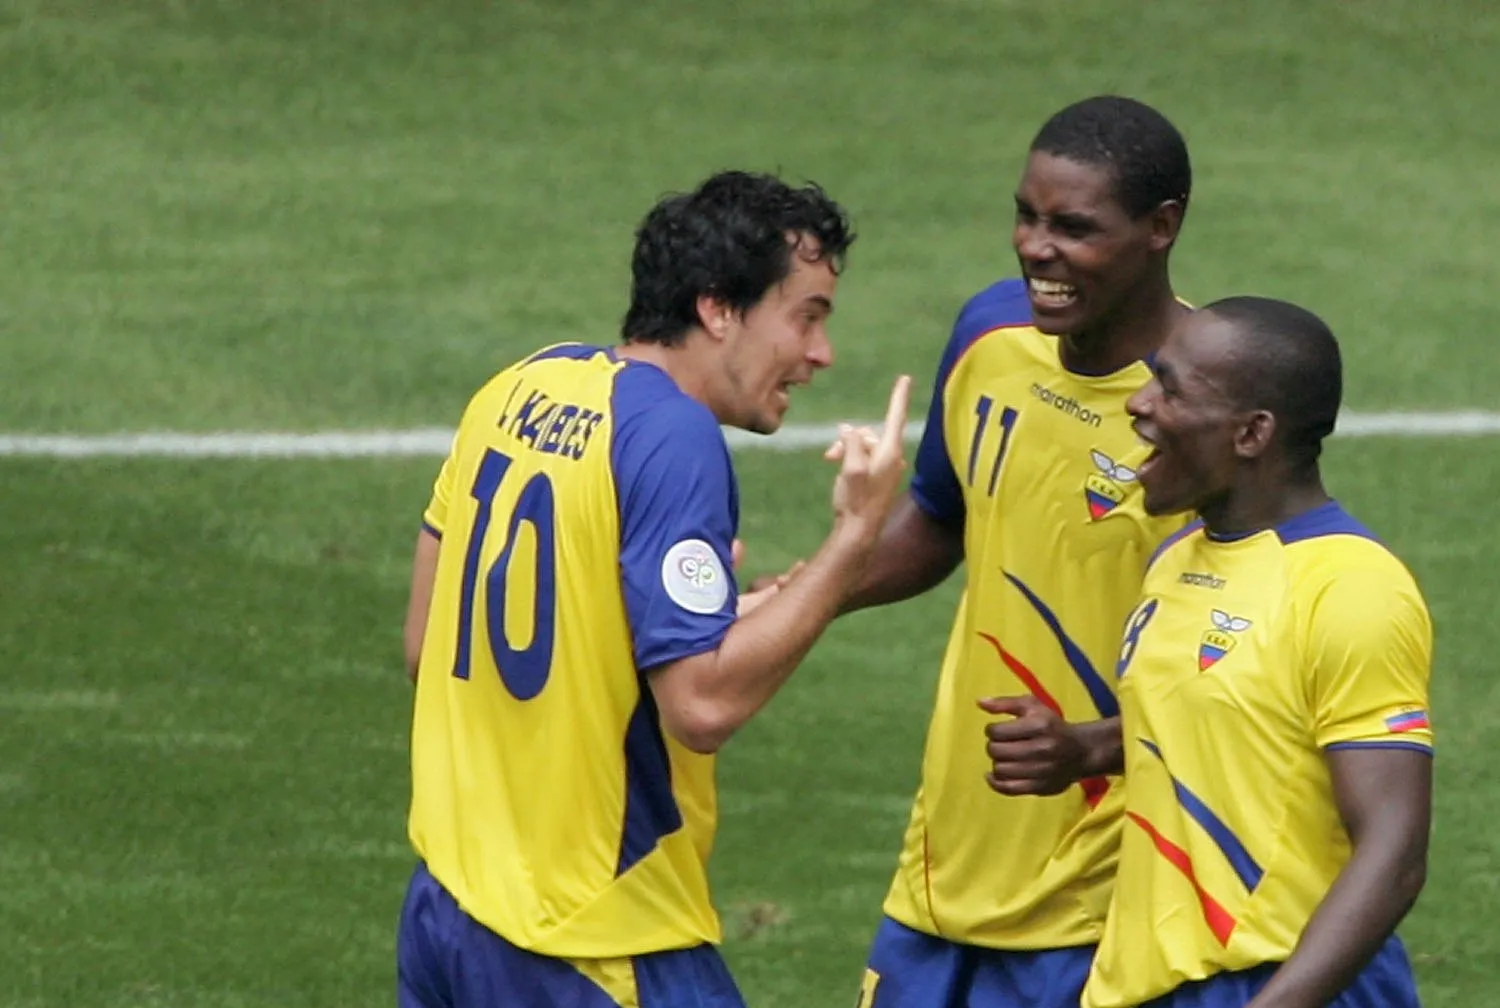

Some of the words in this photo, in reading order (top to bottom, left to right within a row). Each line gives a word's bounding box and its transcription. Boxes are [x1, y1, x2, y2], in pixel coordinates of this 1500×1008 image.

[968, 394, 1018, 497] 11
[1031, 382, 1102, 428] marathon
[452, 447, 556, 701] 10
[1114, 598, 1158, 679] 8
